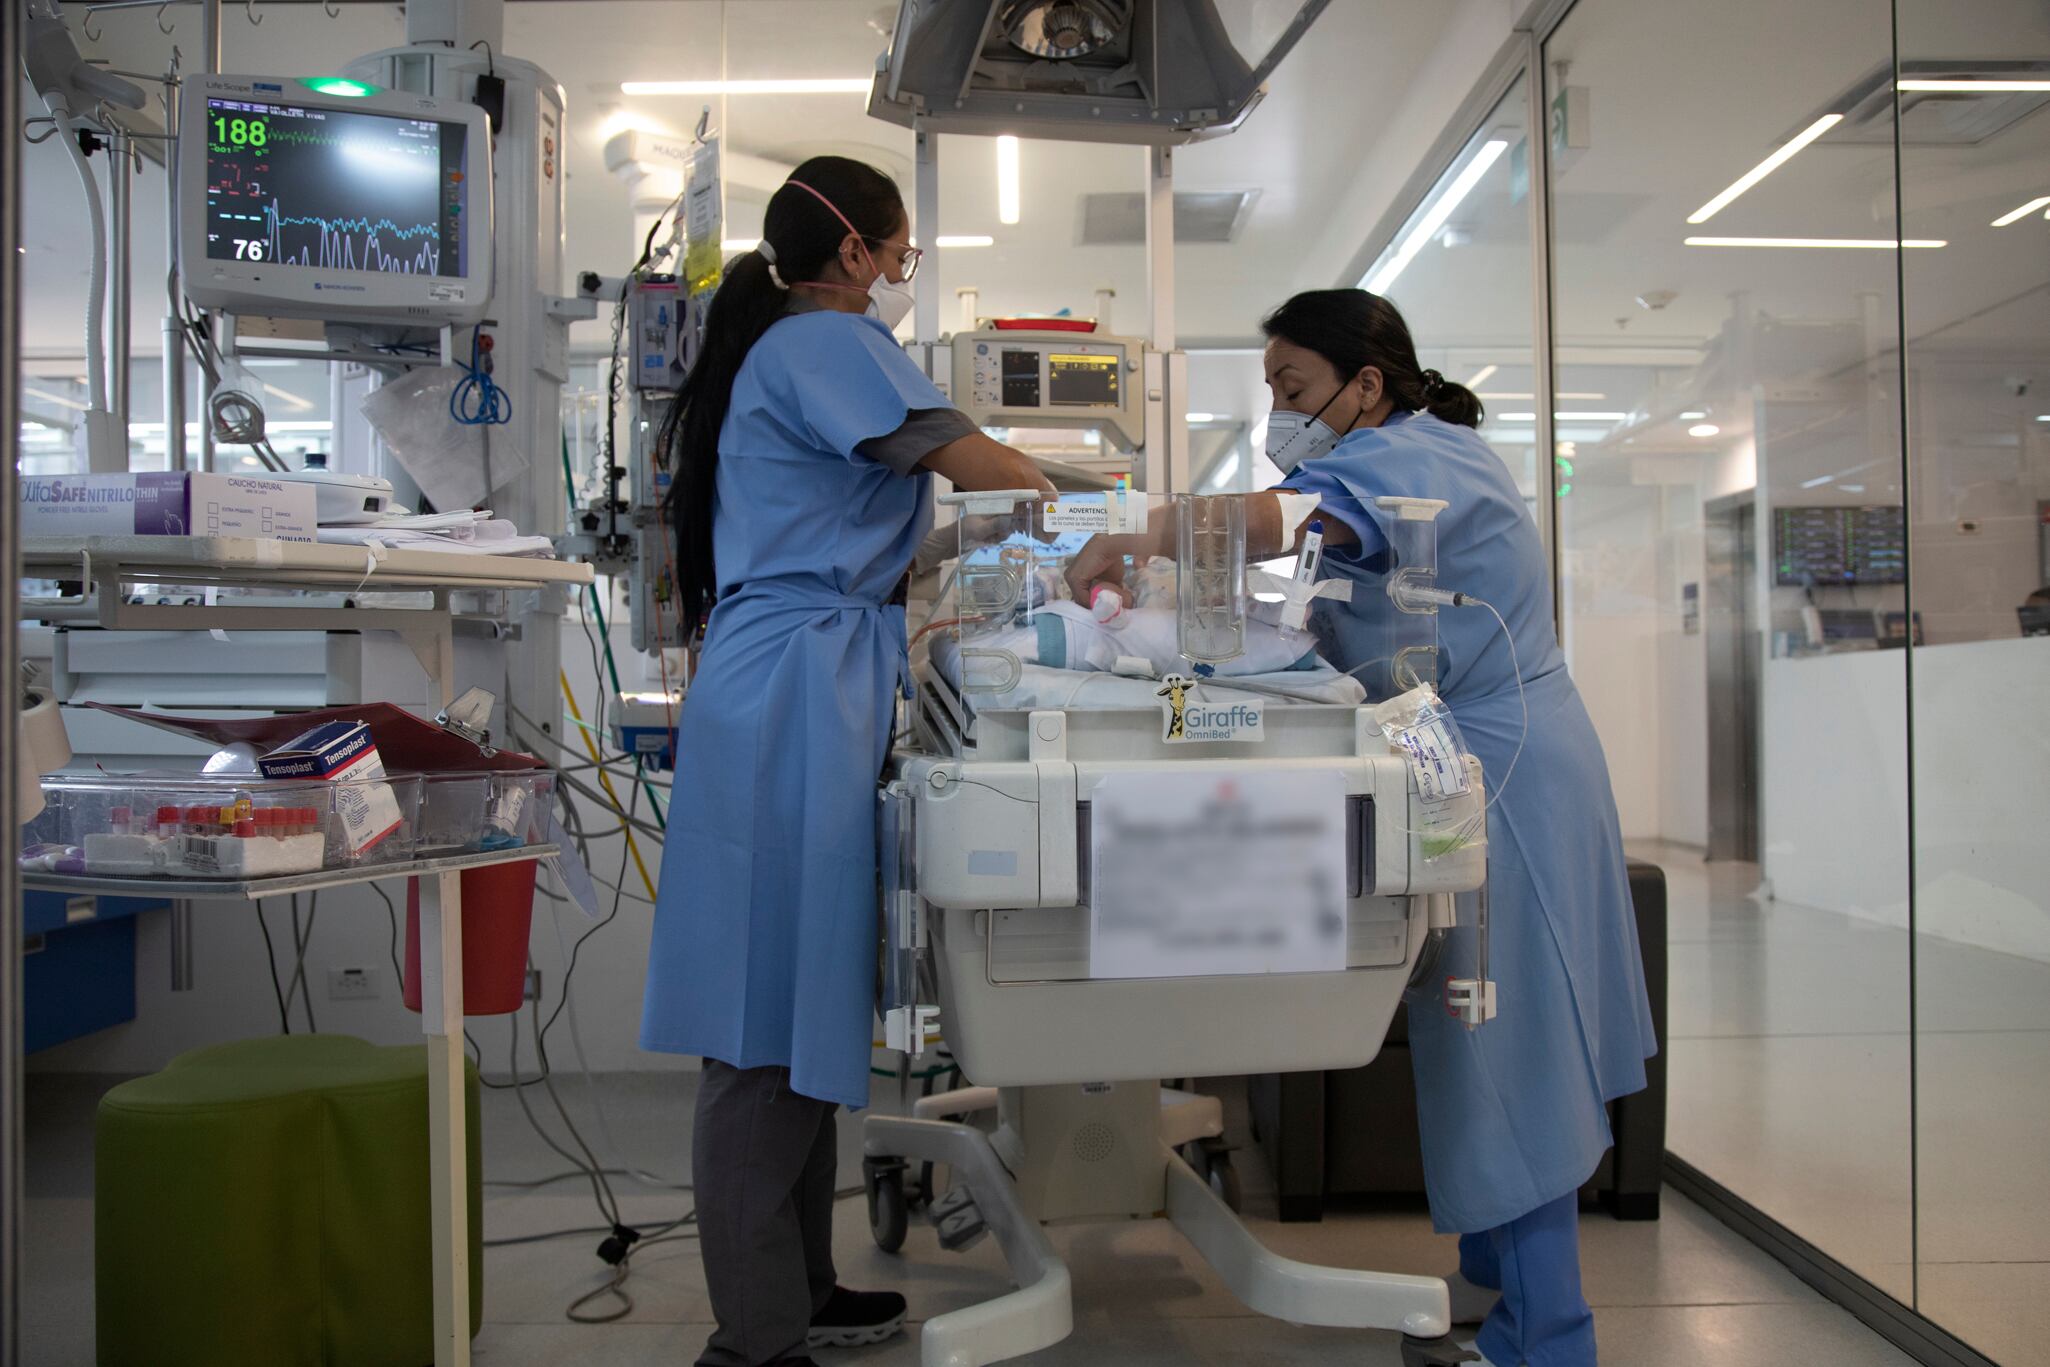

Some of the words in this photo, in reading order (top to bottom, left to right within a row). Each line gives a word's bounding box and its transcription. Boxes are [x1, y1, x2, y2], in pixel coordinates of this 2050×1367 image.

[206, 82, 221, 90] Life
[223, 83, 250, 92] Scope
[214, 117, 267, 147] 188
[233, 239, 263, 261] 76
[228, 478, 256, 489] CAUCHO
[258, 482, 283, 492] NATURAL
[87, 487, 134, 503] NITRILO
[135, 487, 158, 499] THIN
[1185, 706, 1258, 728] Giraffe
[1185, 729, 1231, 739] OmniBed
[324, 735, 367, 766] Tensoplast
[264, 762, 313, 776] Tensoplast
